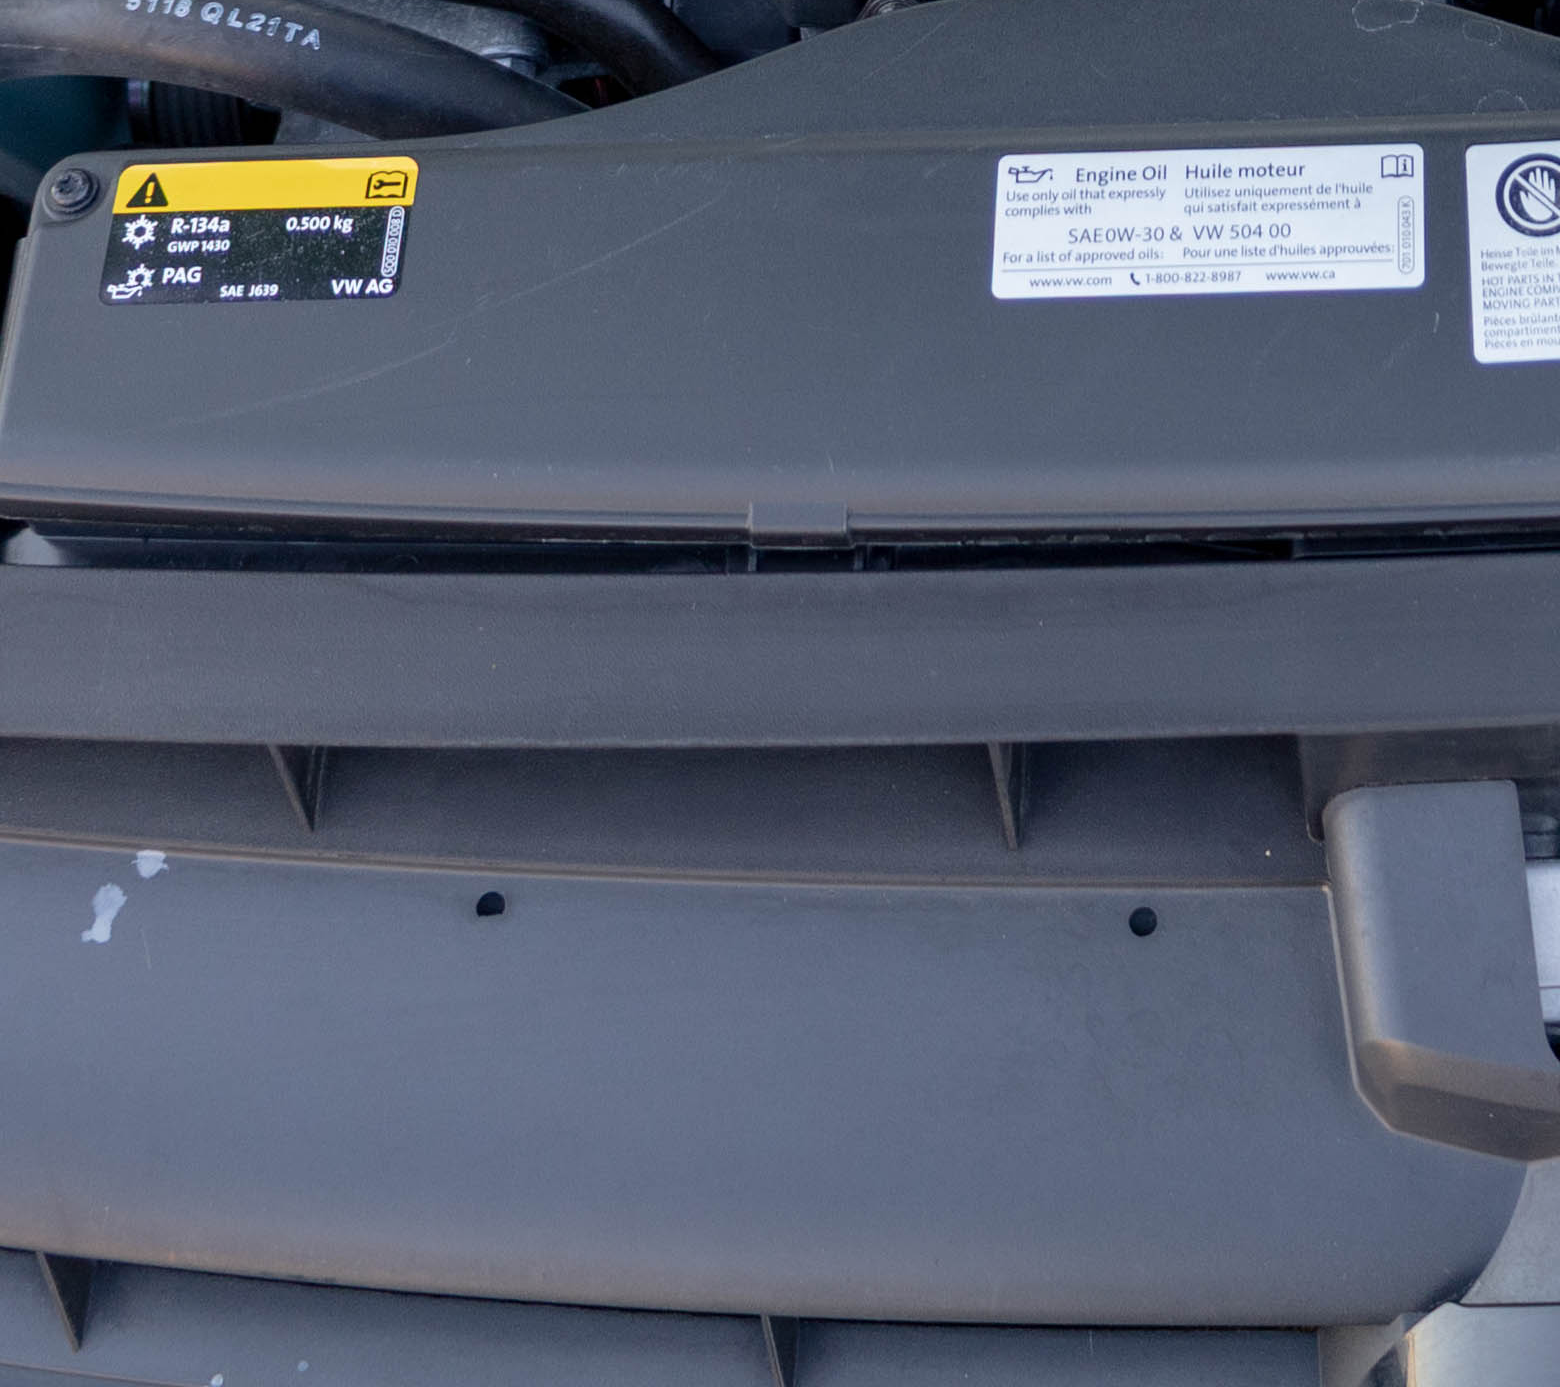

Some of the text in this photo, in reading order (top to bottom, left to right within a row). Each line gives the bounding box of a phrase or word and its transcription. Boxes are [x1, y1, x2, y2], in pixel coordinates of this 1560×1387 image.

[1076, 163, 1305, 186] Engine Oil Huile moteur
[1006, 187, 1166, 204] Use only oil that expressly
[1184, 183, 1373, 200] Utilisez uniquement de l'huile
[170, 216, 354, 234] R-134a 0.500 kg
[1069, 223, 1291, 244] SAE0W-30 & VW 504 00
[167, 239, 230, 253] GWP 1430
[162, 267, 202, 283] PAG
[1029, 269, 1335, 287] www.vw.com 1-800-822-8987 www.vw.ca
[220, 284, 278, 297] SAE J639
[331, 279, 393, 295] VW AG
